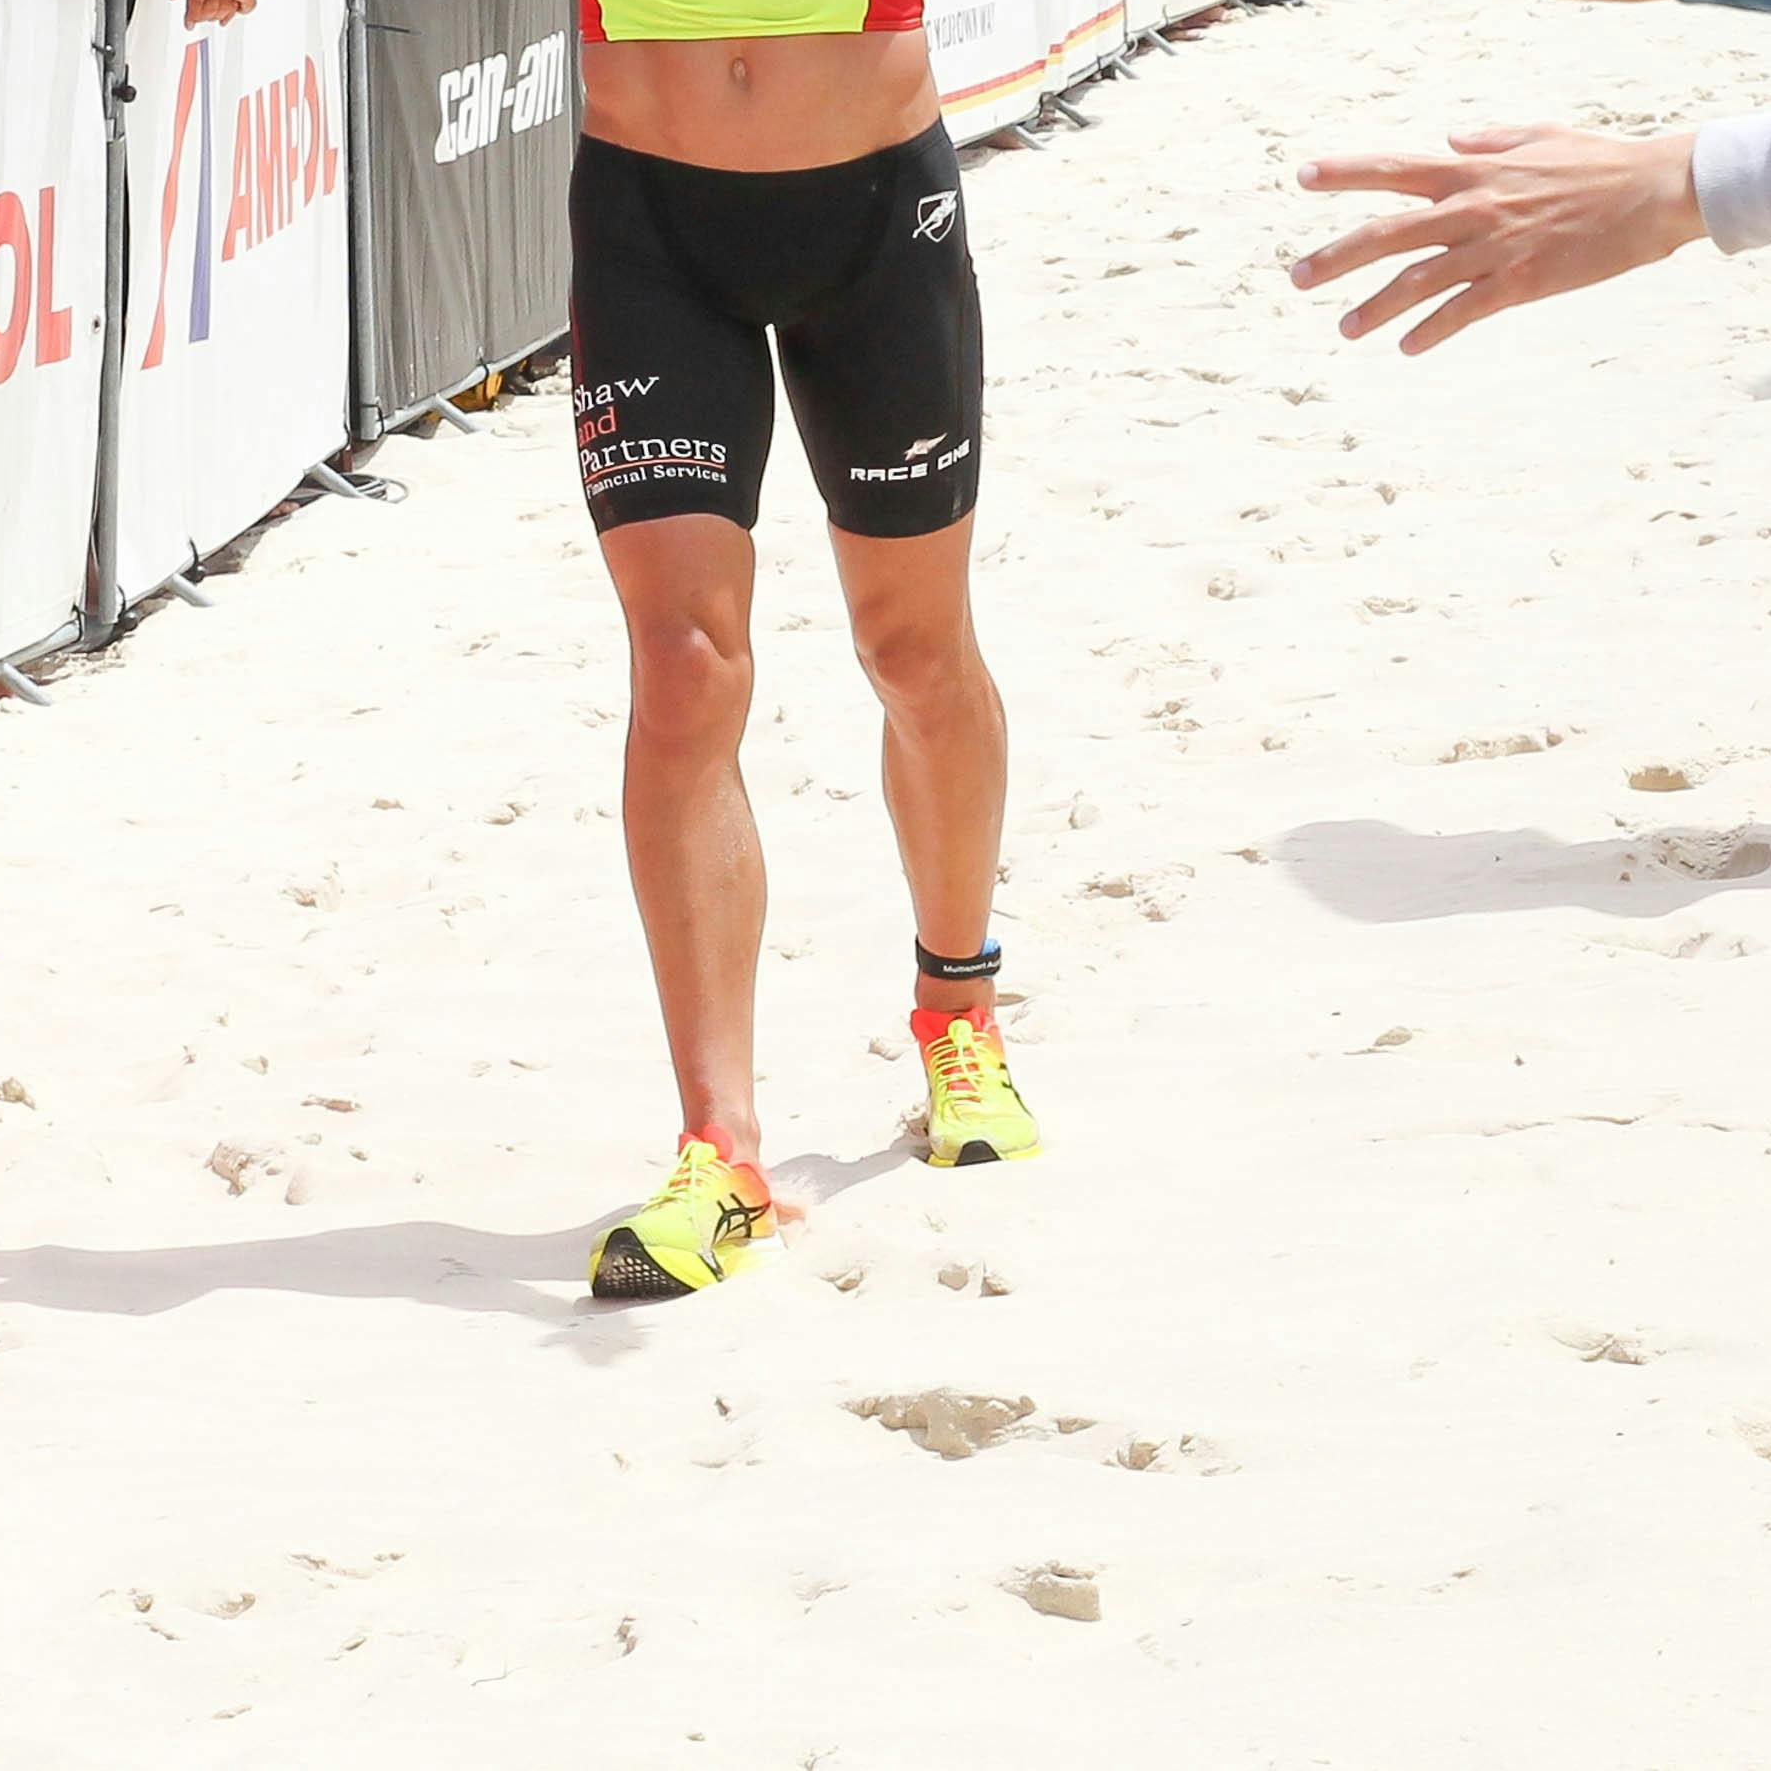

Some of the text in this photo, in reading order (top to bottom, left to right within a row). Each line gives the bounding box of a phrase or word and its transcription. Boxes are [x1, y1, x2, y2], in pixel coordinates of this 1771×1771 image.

[434, 29, 565, 165] can-am
[220, 56, 340, 264] AMPOL
[573, 376, 661, 417] Shaw
[580, 437, 728, 479] Partners
[850, 438, 970, 481] RACE ONE
[586, 464, 728, 500] Financial Services
